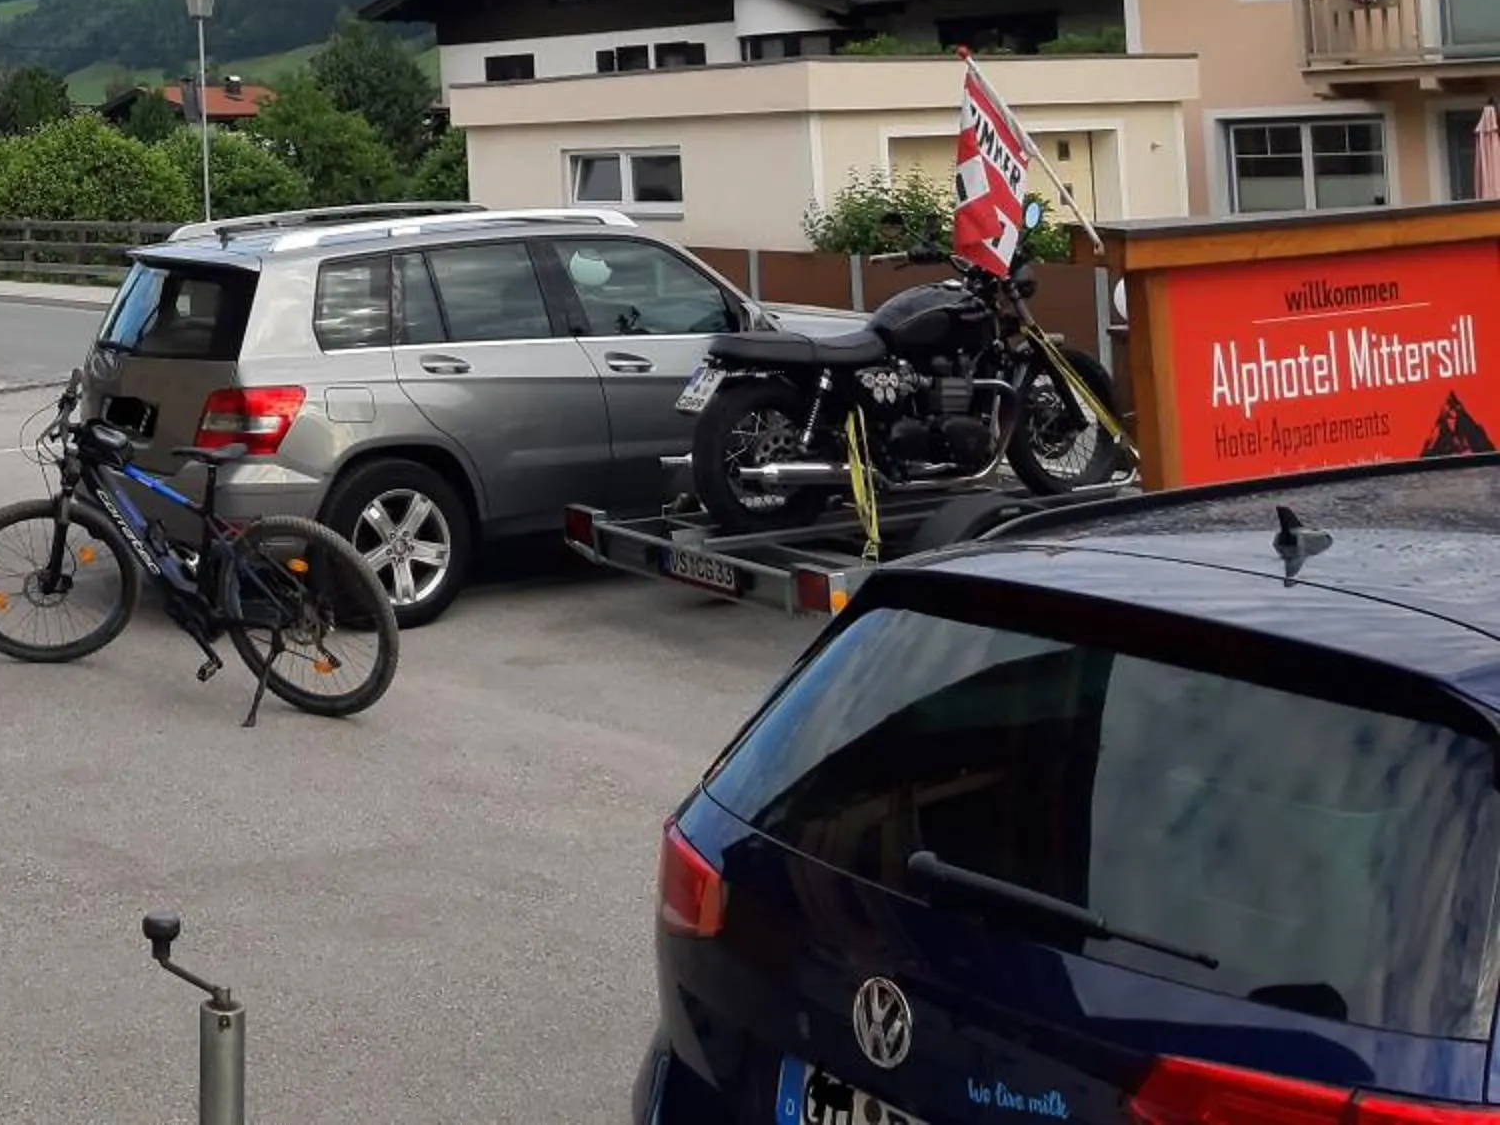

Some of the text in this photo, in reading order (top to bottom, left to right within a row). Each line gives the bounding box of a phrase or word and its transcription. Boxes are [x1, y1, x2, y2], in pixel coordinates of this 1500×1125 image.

[1284, 280, 1399, 311] willkommen
[1212, 314, 1477, 418] Alphotel Mittersill
[1214, 410, 1391, 459] Hotel-Appartements
